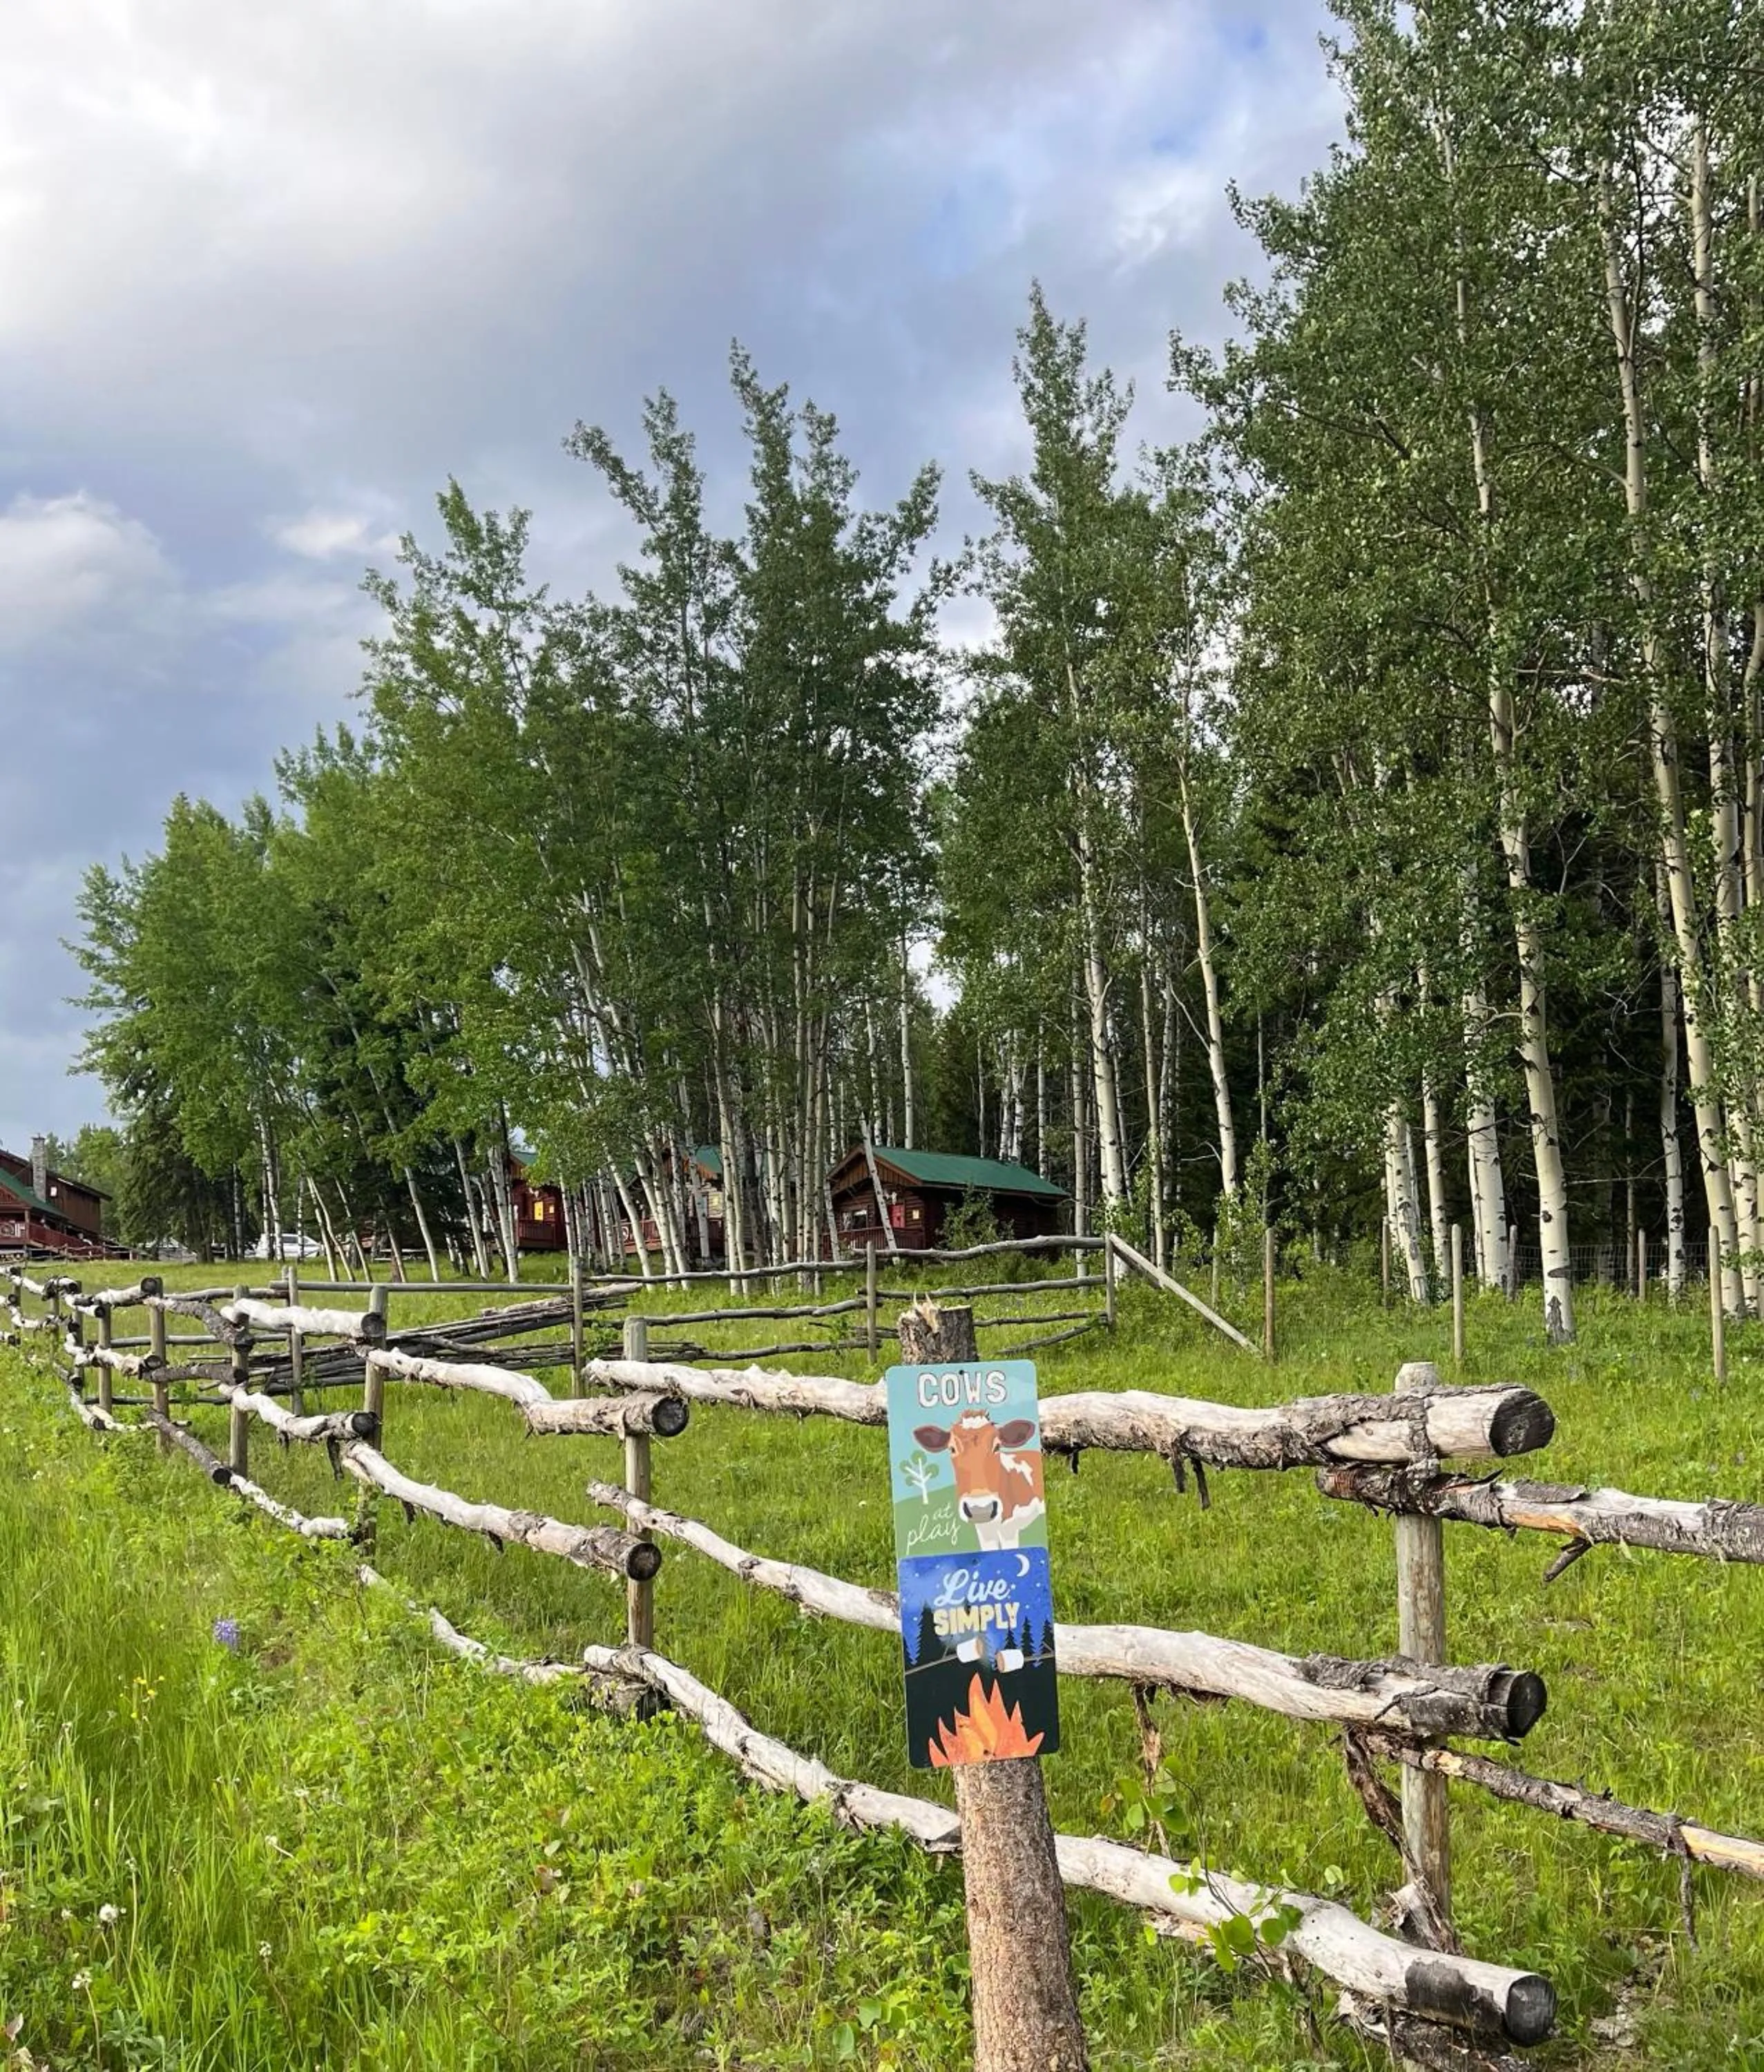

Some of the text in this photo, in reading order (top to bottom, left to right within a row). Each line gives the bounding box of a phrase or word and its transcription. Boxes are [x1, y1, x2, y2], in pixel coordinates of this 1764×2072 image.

[917, 1370, 1007, 1408] COWS
[933, 1502, 955, 1519] at
[906, 1514, 961, 1555] play
[934, 1569, 1010, 1606] Live
[933, 1602, 1019, 1635] SIMPLY
